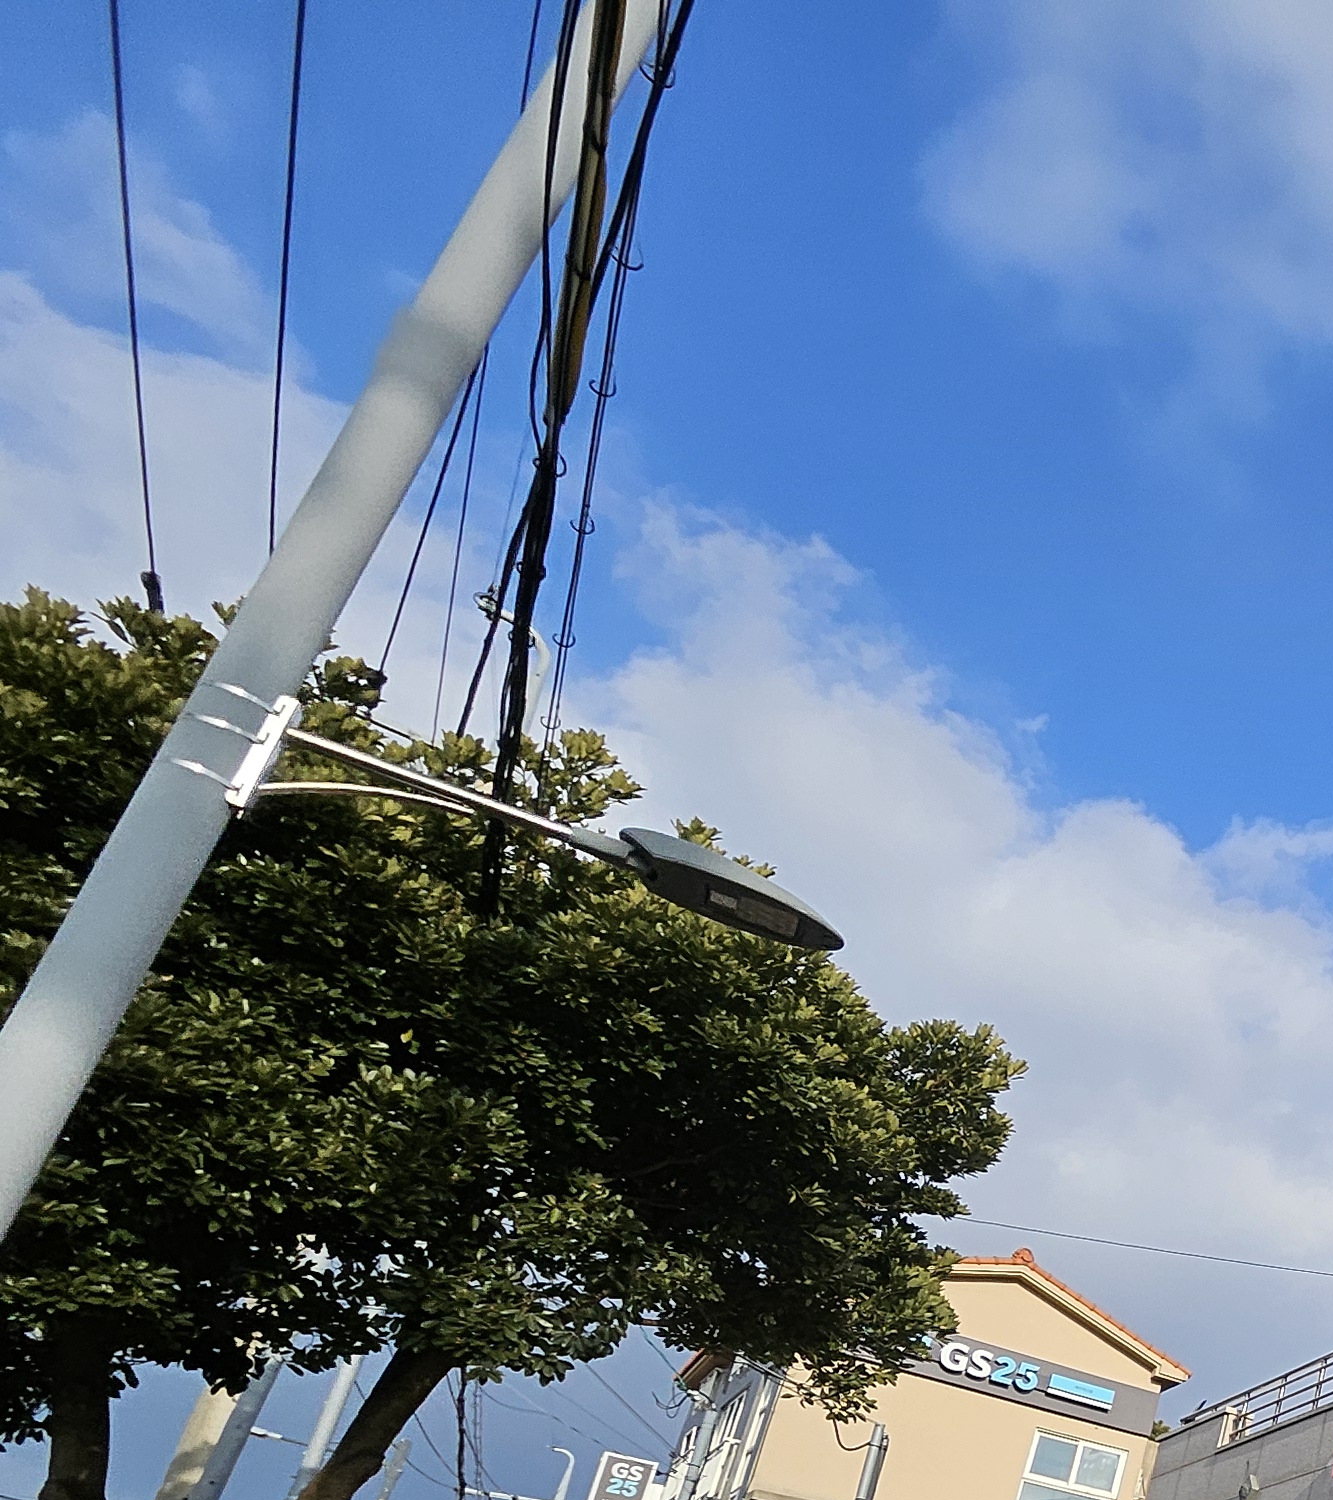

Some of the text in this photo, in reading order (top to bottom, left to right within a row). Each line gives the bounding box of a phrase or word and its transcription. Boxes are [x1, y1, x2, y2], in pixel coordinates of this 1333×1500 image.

[940, 1342, 1041, 1391] GS25
[611, 1462, 645, 1482] GS
[605, 1478, 640, 1497] 25
